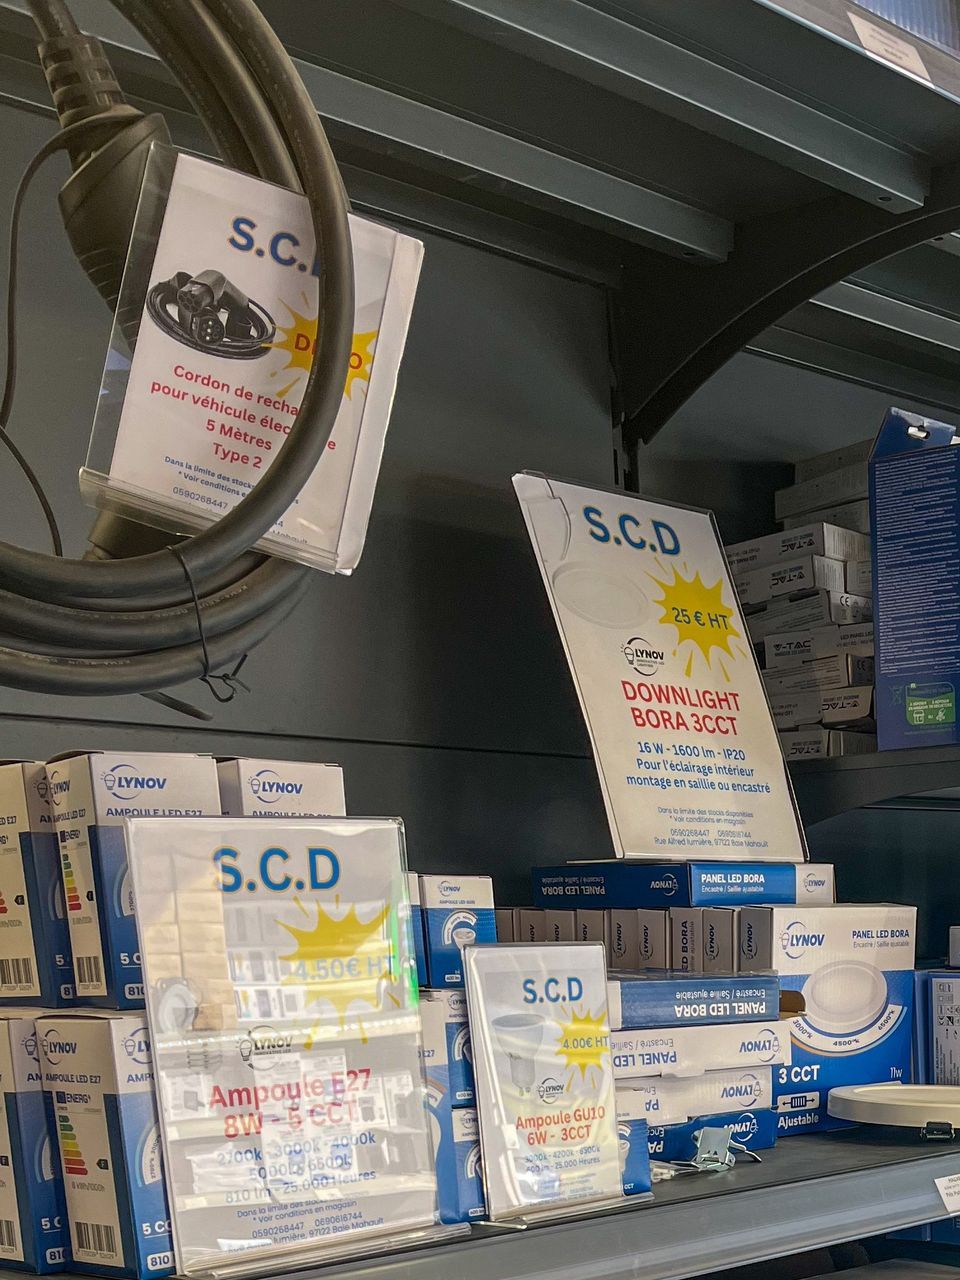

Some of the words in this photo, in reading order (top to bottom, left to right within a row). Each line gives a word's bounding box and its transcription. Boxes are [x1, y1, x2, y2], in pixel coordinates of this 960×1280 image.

[173, 365, 230, 394] Cordon
[234, 385, 253, 401] de
[257, 394, 301, 416] recha
[151, 381, 188, 401] pour
[192, 393, 256, 423] véhicule
[206, 418, 215, 431] 5
[219, 422, 273, 450] Mètres
[213, 442, 250, 465] Type
[253, 455, 263, 469] 2
[184, 472, 199, 484] Voir
[200, 478, 241, 496] conditions
[172, 486, 228, 510] 0590268447
[583, 506, 681, 556] S.C.D
[672, 607, 691, 625] 25
[694, 611, 706, 627] €
[707, 613, 729, 630] HT
[621, 680, 740, 712] DOWNLIGHT
[631, 707, 690, 732] BORA
[690, 712, 738, 736] 3CCT
[636, 758, 661, 770] Pour
[663, 760, 713, 776] l'éclairage
[715, 763, 754, 777] intérieur
[117, 777, 168, 790] LYNOV
[262, 781, 303, 794] LYNOV
[212, 845, 341, 893] S.C.D
[700, 874, 726, 883] PANEL
[727, 874, 742, 883] LED
[744, 873, 765, 883] BORA
[542, 886, 563, 896] BORA
[565, 886, 579, 895] LED
[581, 886, 605, 895] PANEL
[789, 933, 825, 946] LYNOV
[851, 929, 875, 939] PANEL
[876, 929, 889, 938] LED
[890, 929, 910, 938] BORA
[523, 976, 583, 1004] S.C.D
[674, 1003, 706, 1018] BORA
[709, 1002, 729, 1015] LED
[735, 1002, 766, 1014] PANEL
[49, 1041, 77, 1054] LYNOV
[254, 1037, 293, 1051] LYNOV
[563, 1037, 593, 1050] 4.00€
[595, 1035, 609, 1048] HT
[45, 1073, 75, 1083] AMPOULE
[76, 1075, 88, 1084] LED
[90, 1075, 101, 1084] E27
[777, 1069, 788, 1084] 3
[790, 1065, 820, 1083] CCT
[209, 1073, 324, 1110] Ampoule
[330, 1068, 371, 1095] E27
[515, 1110, 571, 1130] Ampoule
[573, 1106, 605, 1123] GU10
[777, 1113, 819, 1129] Ajustable
[527, 1130, 548, 1146] 6W
[560, 1125, 592, 1141] 3CCT
[259, 1213, 273, 1224] Voir
[275, 1206, 314, 1221] conditions
[315, 1206, 325, 1215] en
[325, 1201, 358, 1214] magasin
[41, 1217, 50, 1229] 5
[252, 1222, 304, 1239] 0590268447
[315, 1211, 363, 1227] 0690616744
[150, 1255, 170, 1265] 810
